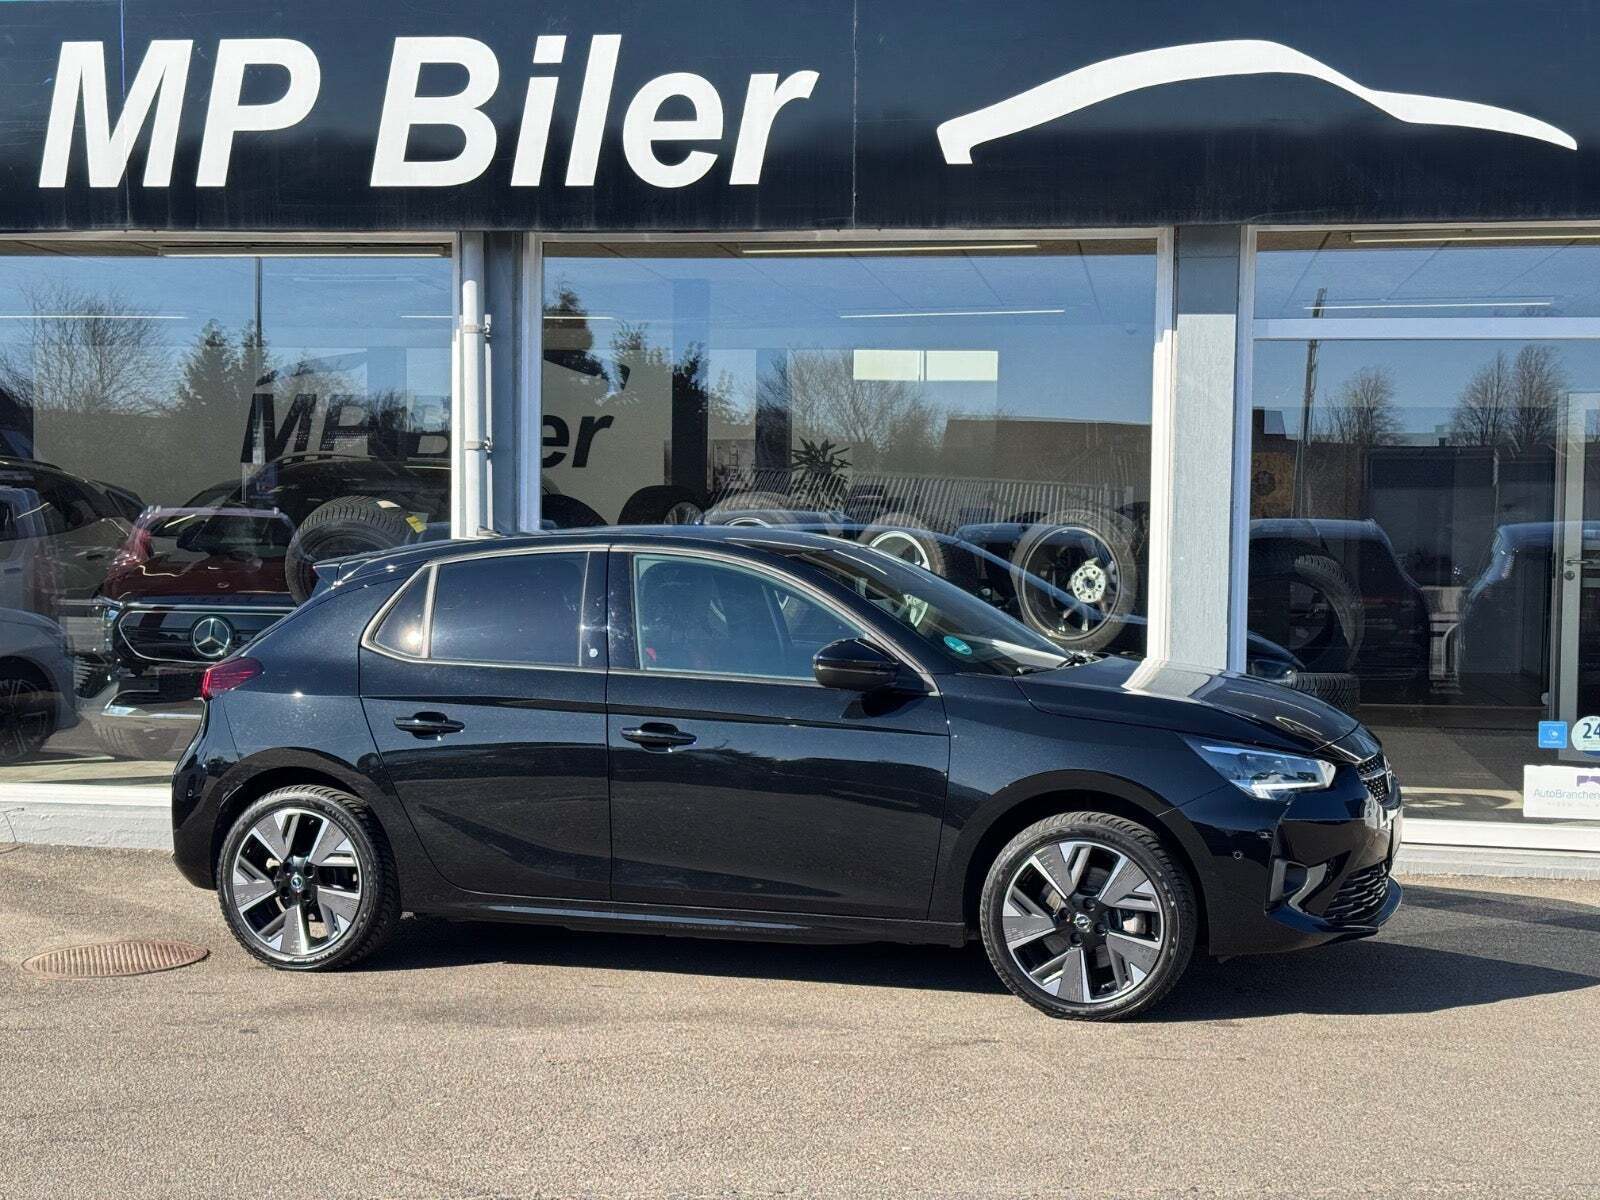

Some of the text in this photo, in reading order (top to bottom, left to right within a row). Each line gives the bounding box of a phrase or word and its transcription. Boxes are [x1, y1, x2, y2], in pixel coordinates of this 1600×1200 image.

[38, 34, 820, 189] MP Biler
[240, 393, 373, 463] MP
